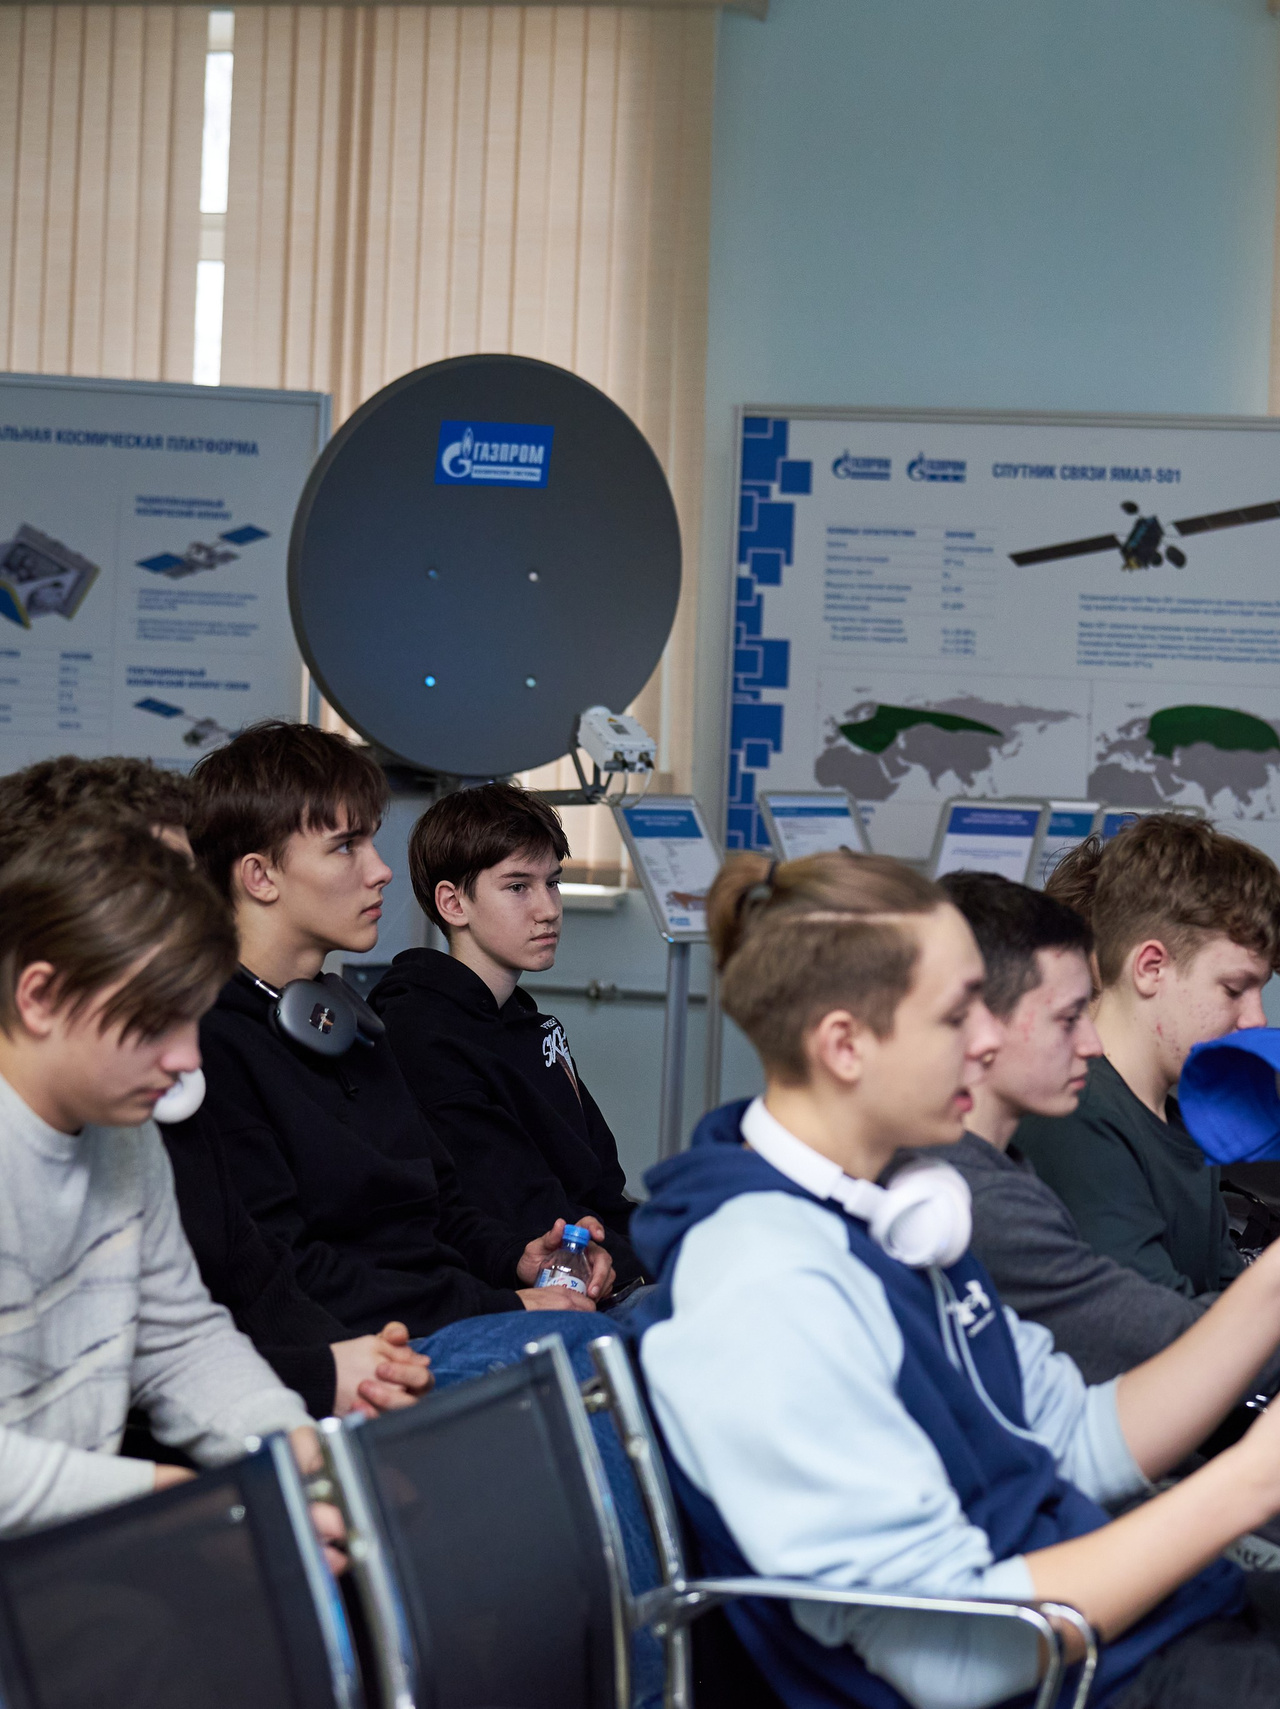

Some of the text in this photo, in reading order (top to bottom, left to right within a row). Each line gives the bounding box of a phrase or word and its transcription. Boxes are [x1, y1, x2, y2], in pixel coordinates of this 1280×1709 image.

[56, 429, 163, 450] КОСМИЧЕСКАЯ
[166, 435, 259, 456] ПЛАТФОРМА
[473, 441, 545, 464] ГАЗПРОМ
[992, 462, 1056, 479] СПУТНИК
[1059, 464, 1107, 481] СВЯЗИ
